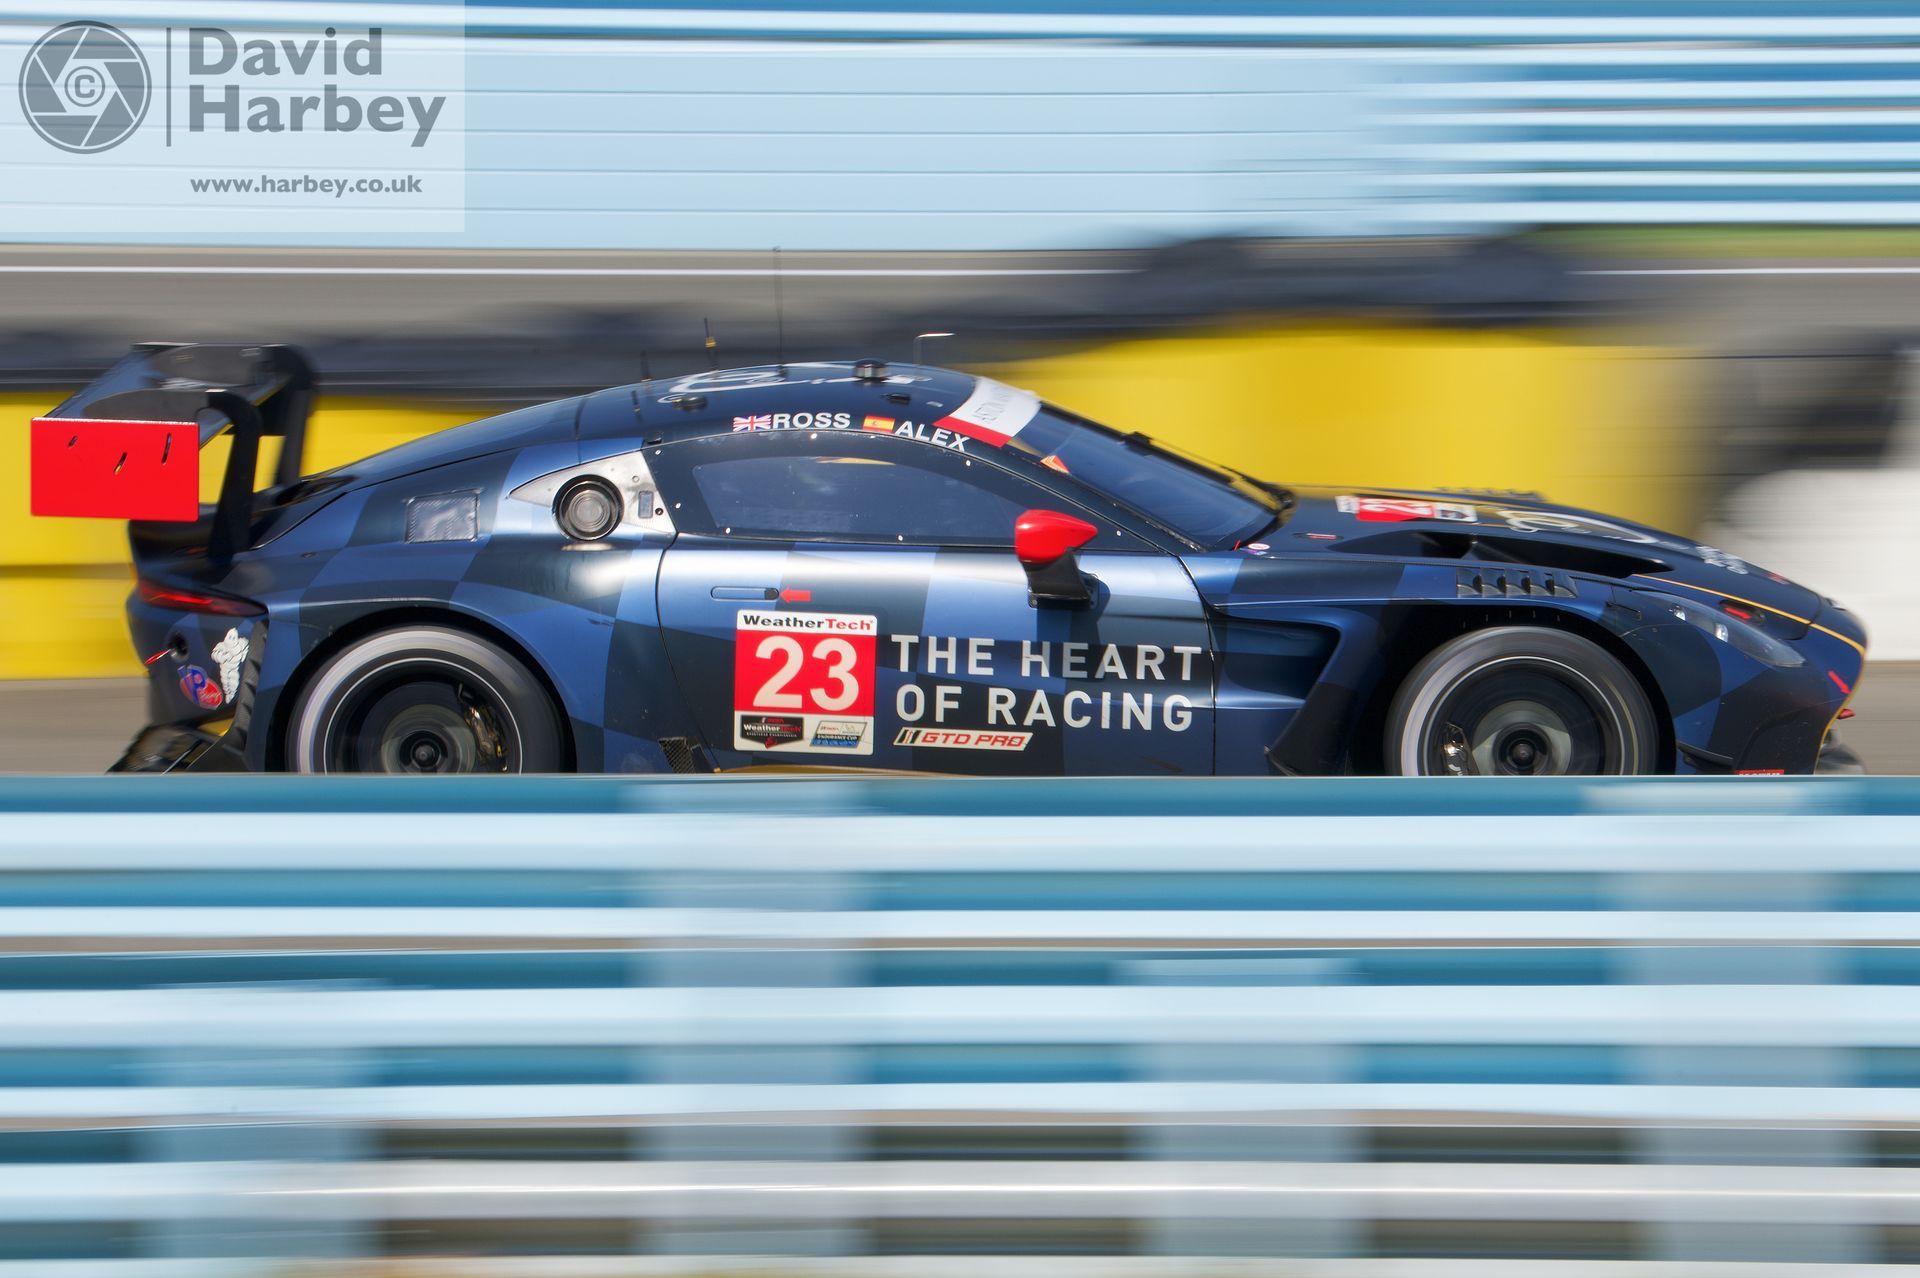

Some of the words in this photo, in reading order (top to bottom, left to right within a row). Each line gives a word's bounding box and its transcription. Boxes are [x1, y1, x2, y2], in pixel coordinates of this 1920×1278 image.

[772, 412, 851, 431] ROSS
[894, 420, 970, 452] ALEX
[743, 614, 871, 631] WeatherTech
[752, 635, 859, 712] 23
[890, 634, 995, 676] THE
[1021, 639, 1202, 681] HEART
[895, 683, 963, 723] OF
[987, 686, 1193, 732] RACING
[921, 732, 970, 745] GTD
[974, 735, 1026, 747] PRO
